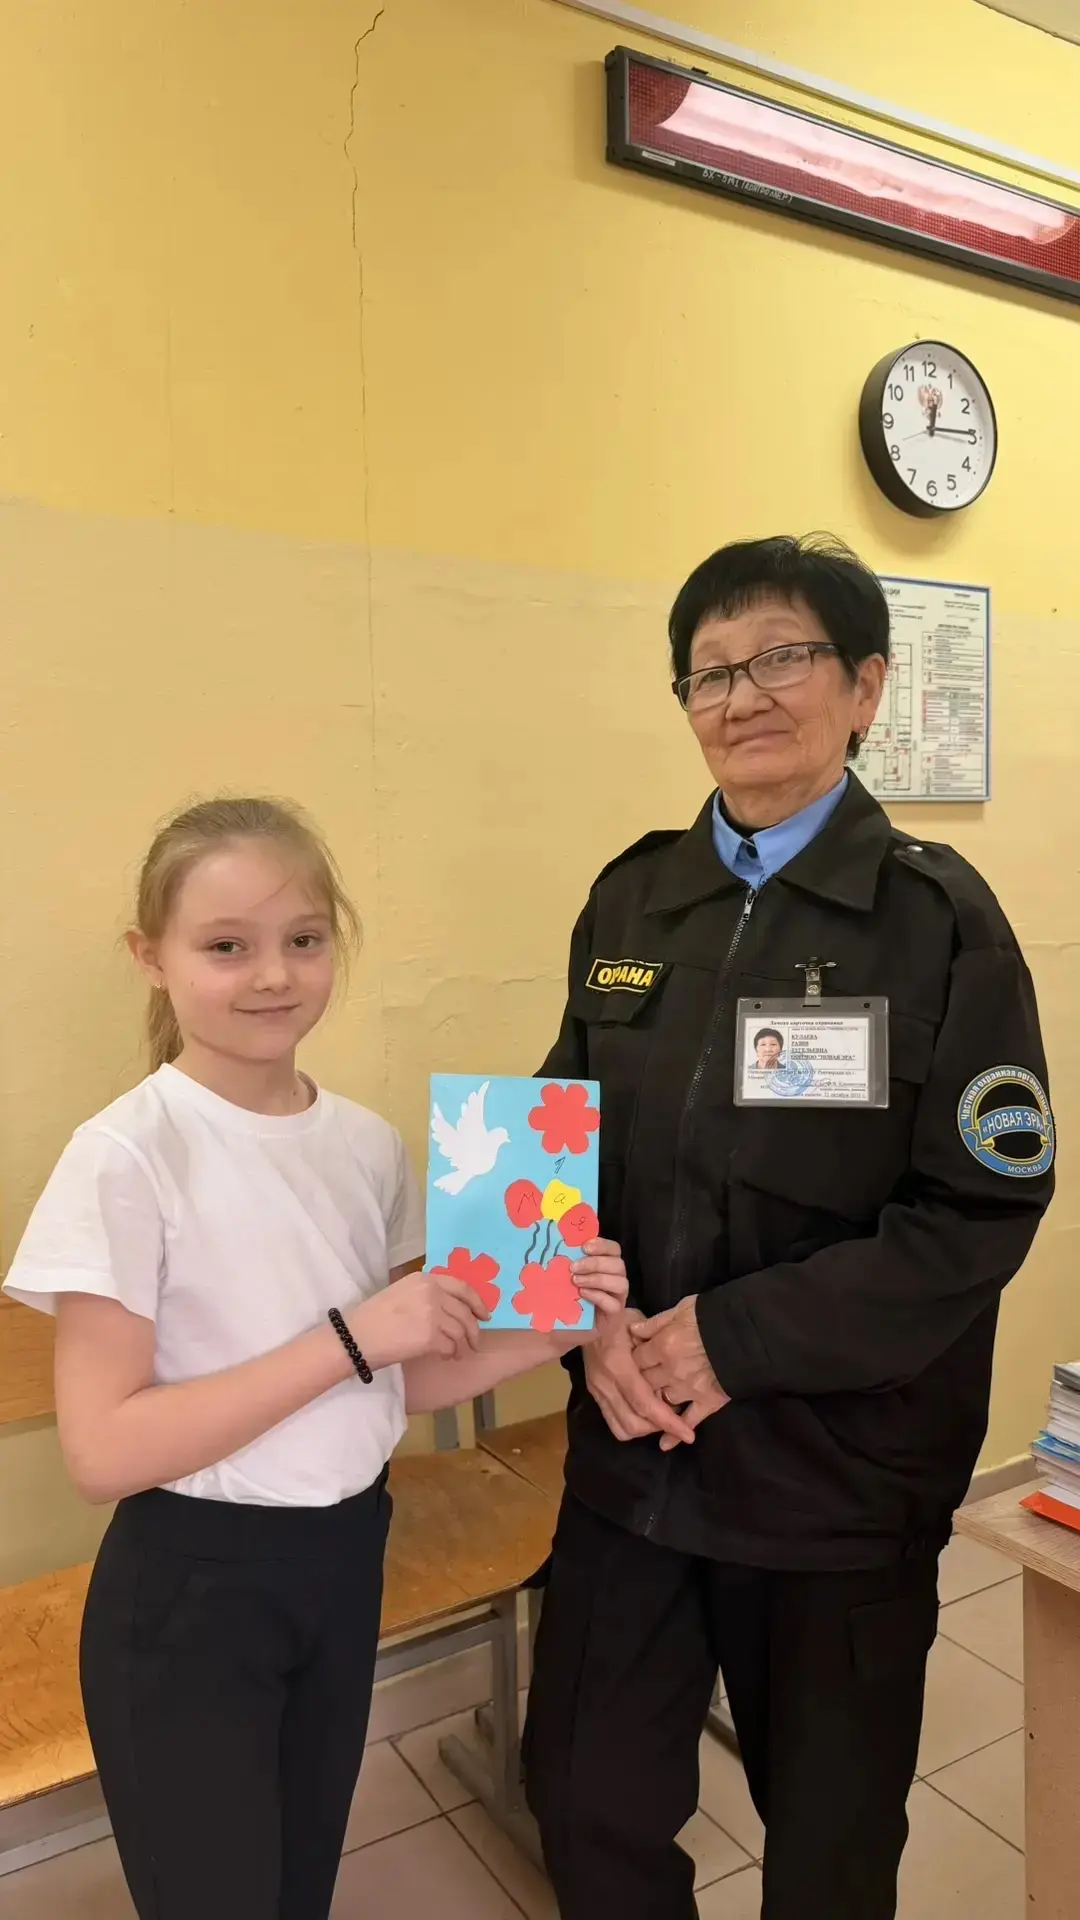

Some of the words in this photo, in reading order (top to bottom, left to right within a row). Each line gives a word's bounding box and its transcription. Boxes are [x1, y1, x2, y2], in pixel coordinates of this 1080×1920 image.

[903, 364, 915, 382] 11
[922, 360, 937, 378] 12
[887, 383, 904, 401] 10
[961, 398, 970, 415] 2
[882, 412, 894, 429] 9
[890, 444, 901, 461] 8
[961, 456, 971, 473] 4
[907, 468, 917, 485] 7
[947, 474, 957, 491] 5
[926, 480, 938, 497] 6
[1007, 1164, 1042, 1174] МОСКВА
